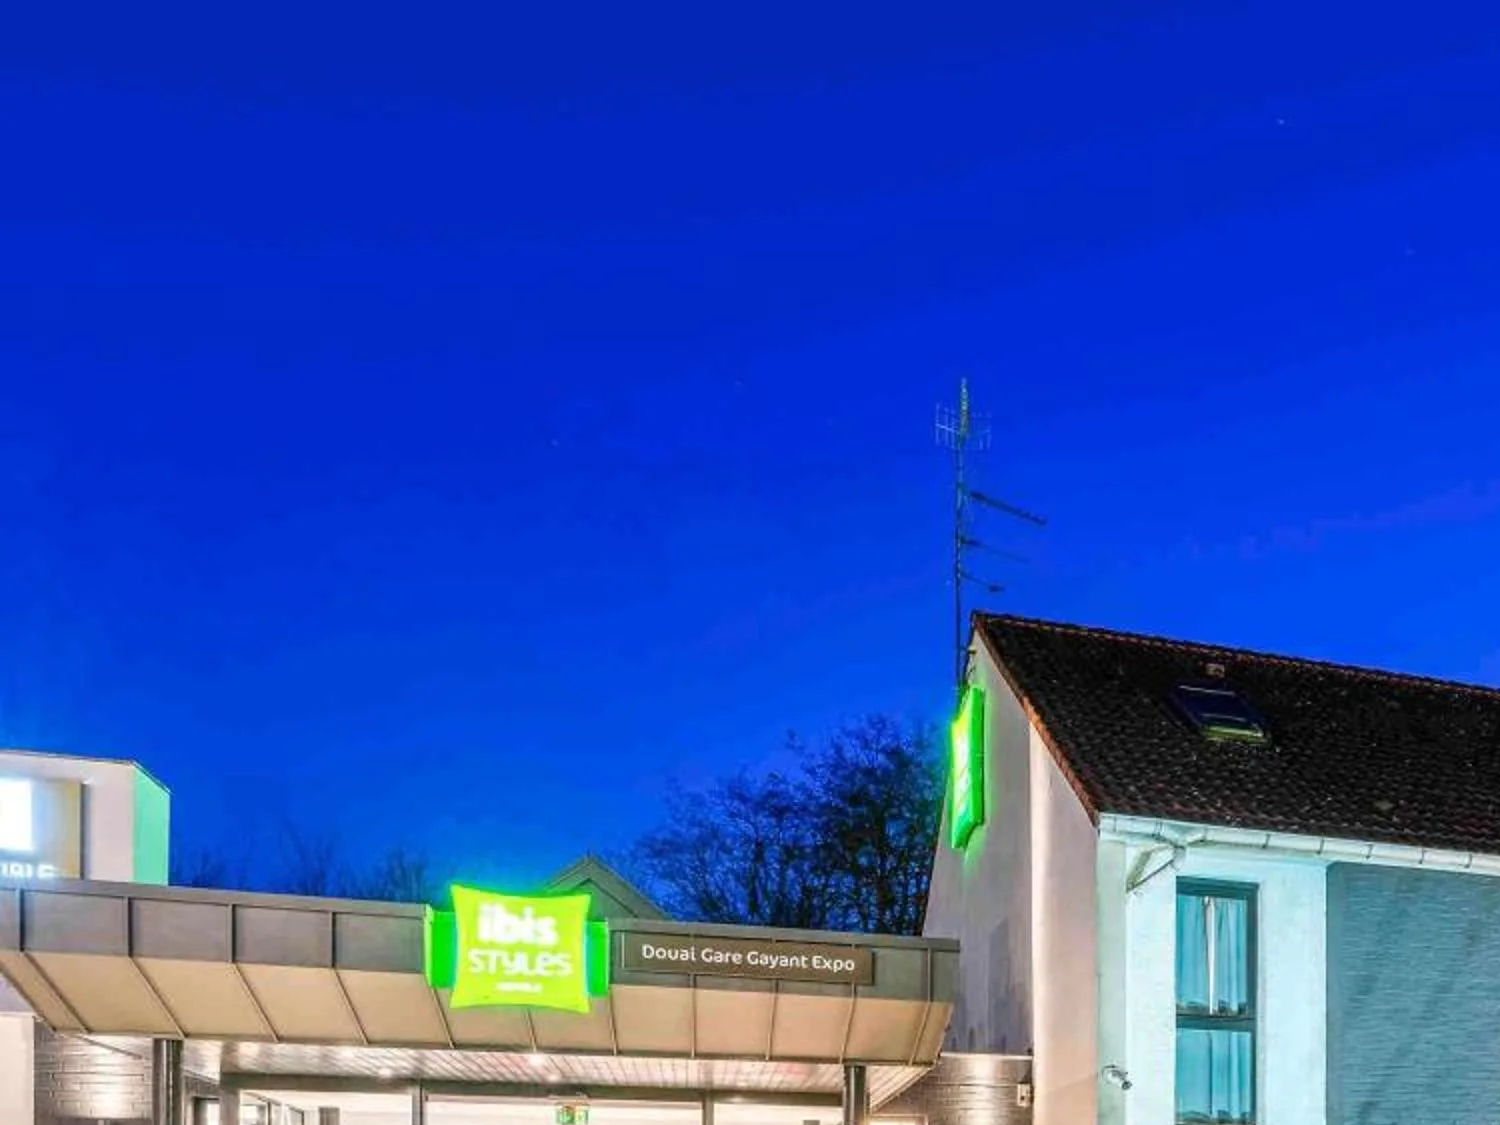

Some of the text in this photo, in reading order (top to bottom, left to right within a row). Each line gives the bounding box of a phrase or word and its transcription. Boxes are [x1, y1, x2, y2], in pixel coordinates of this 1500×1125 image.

[477, 901, 559, 946] ibis
[701, 947, 743, 965] Gare
[746, 950, 808, 969] Gayant
[811, 955, 856, 973] Expo
